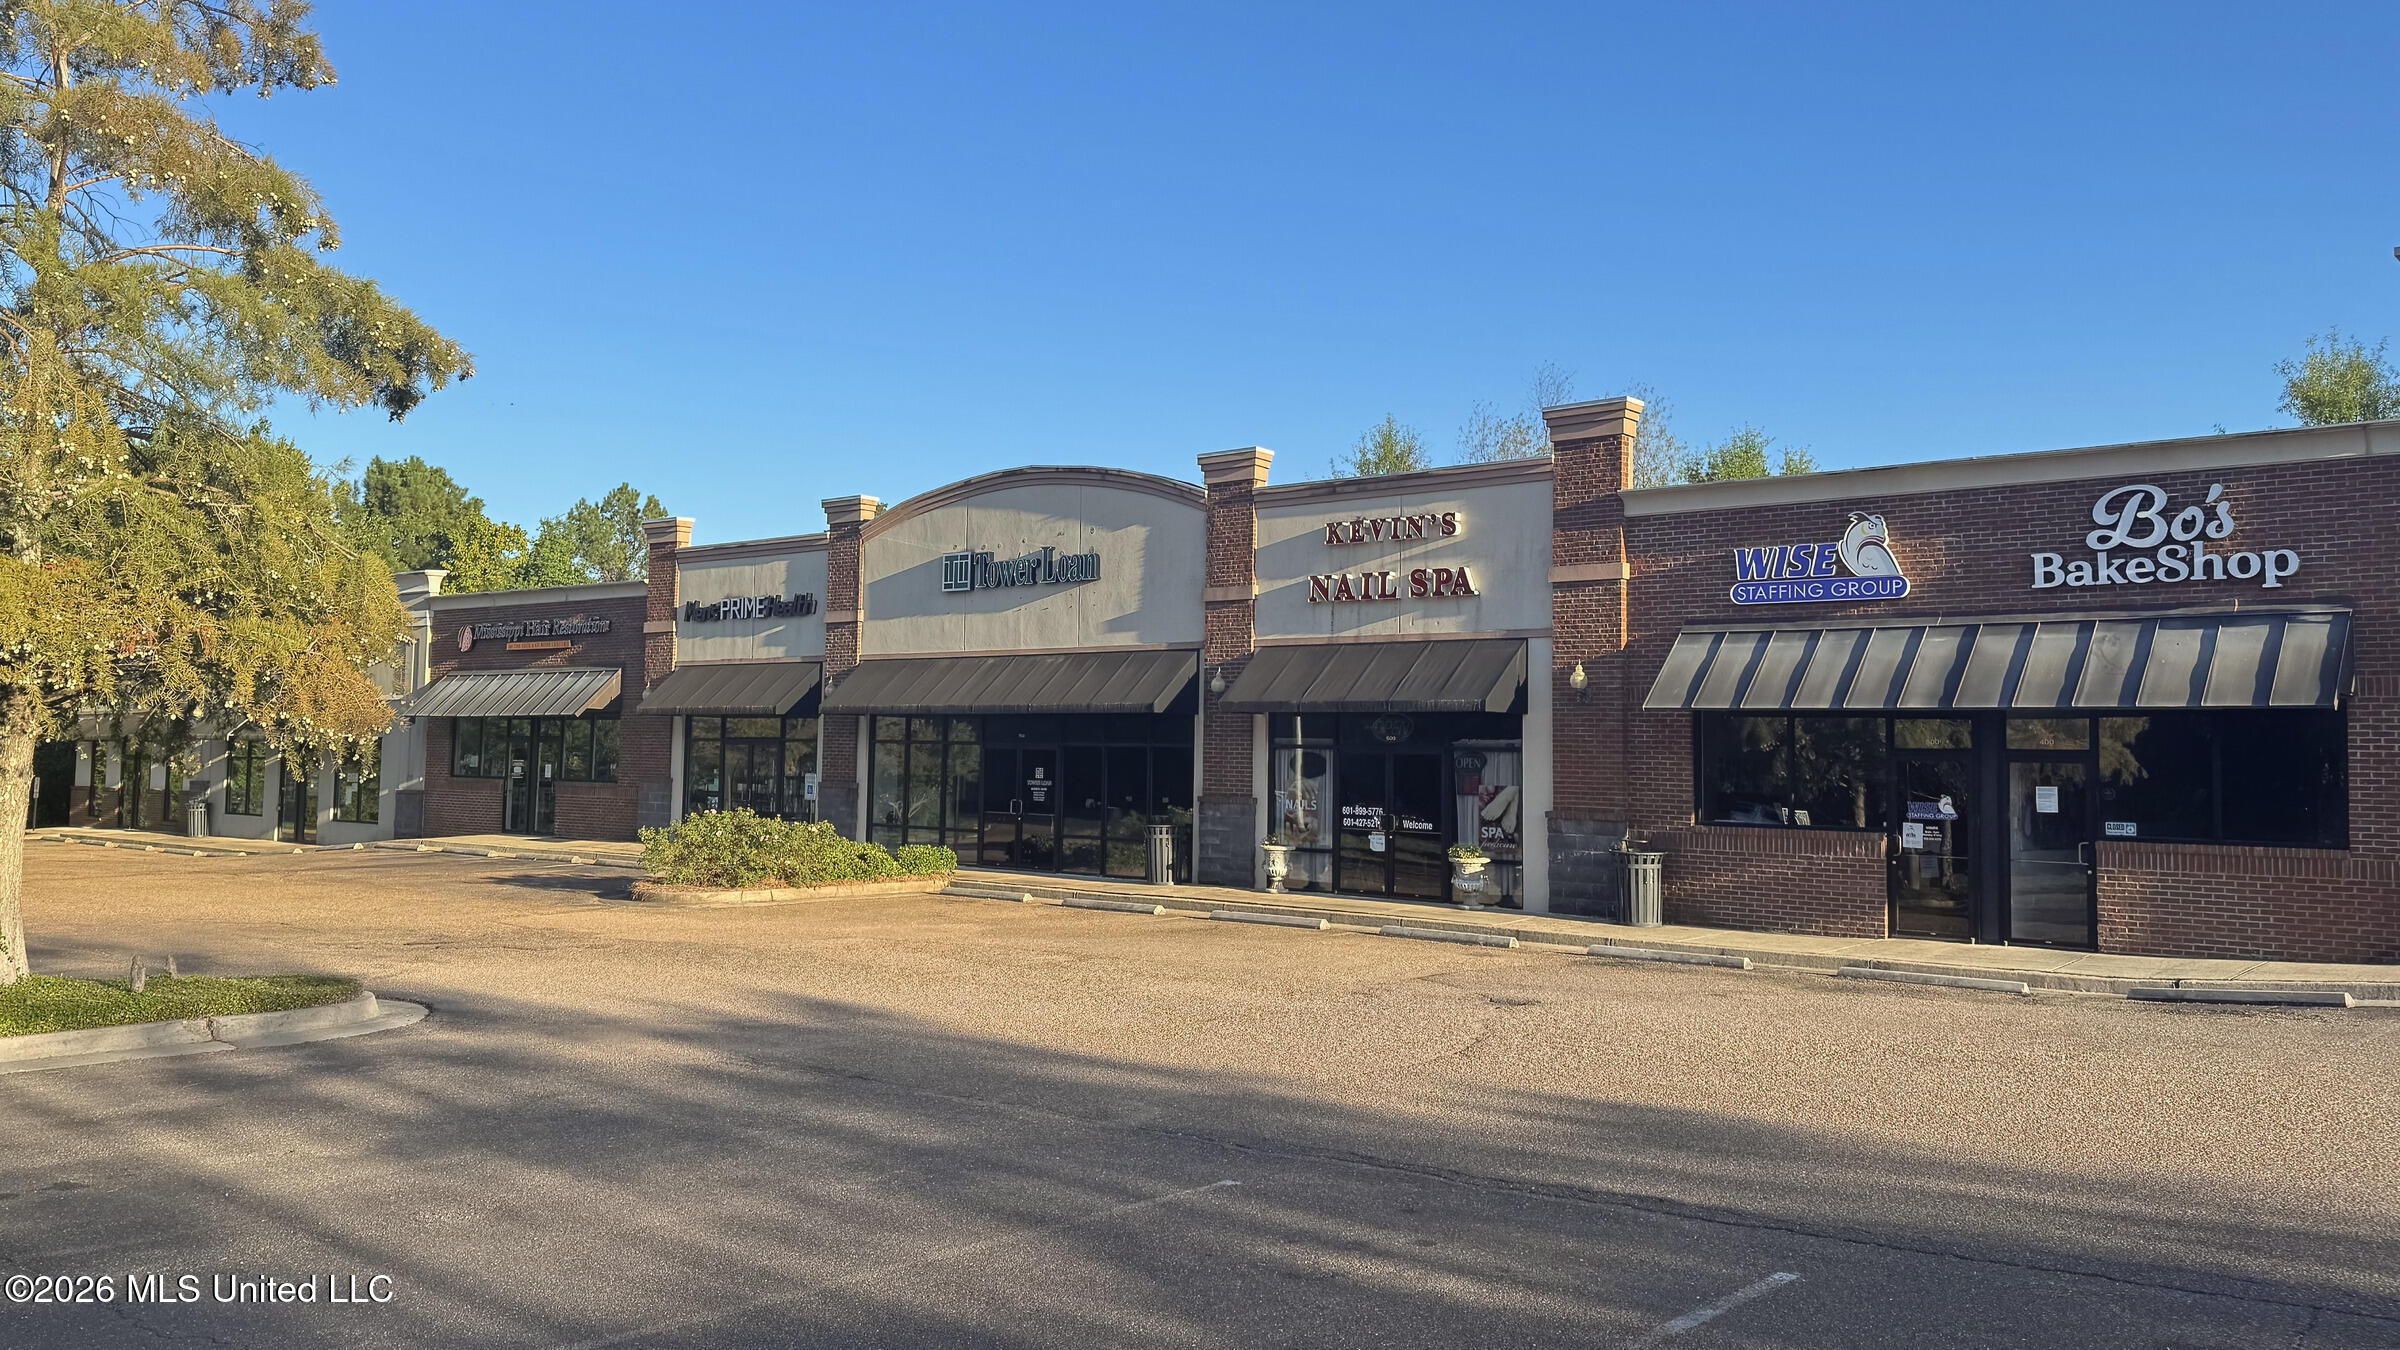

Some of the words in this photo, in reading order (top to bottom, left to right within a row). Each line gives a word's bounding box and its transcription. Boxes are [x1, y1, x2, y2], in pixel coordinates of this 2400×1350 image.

[1325, 511, 1462, 545] KEVIN'S
[2086, 483, 2235, 550] Bo's
[974, 551, 1039, 588] Tower
[1040, 546, 1099, 584] Loan
[1734, 542, 1838, 581] WISE
[2031, 540, 2300, 589] BakeShop
[1308, 570, 1399, 603] NAIL
[1408, 566, 1480, 598] SPA
[1737, 583, 1824, 601] STAFFING
[1831, 580, 1903, 598] GROUP
[1343, 817, 1380, 827] 601-427-521
[1403, 819, 1432, 830] Welcome
[1481, 826, 1504, 839] SPA
